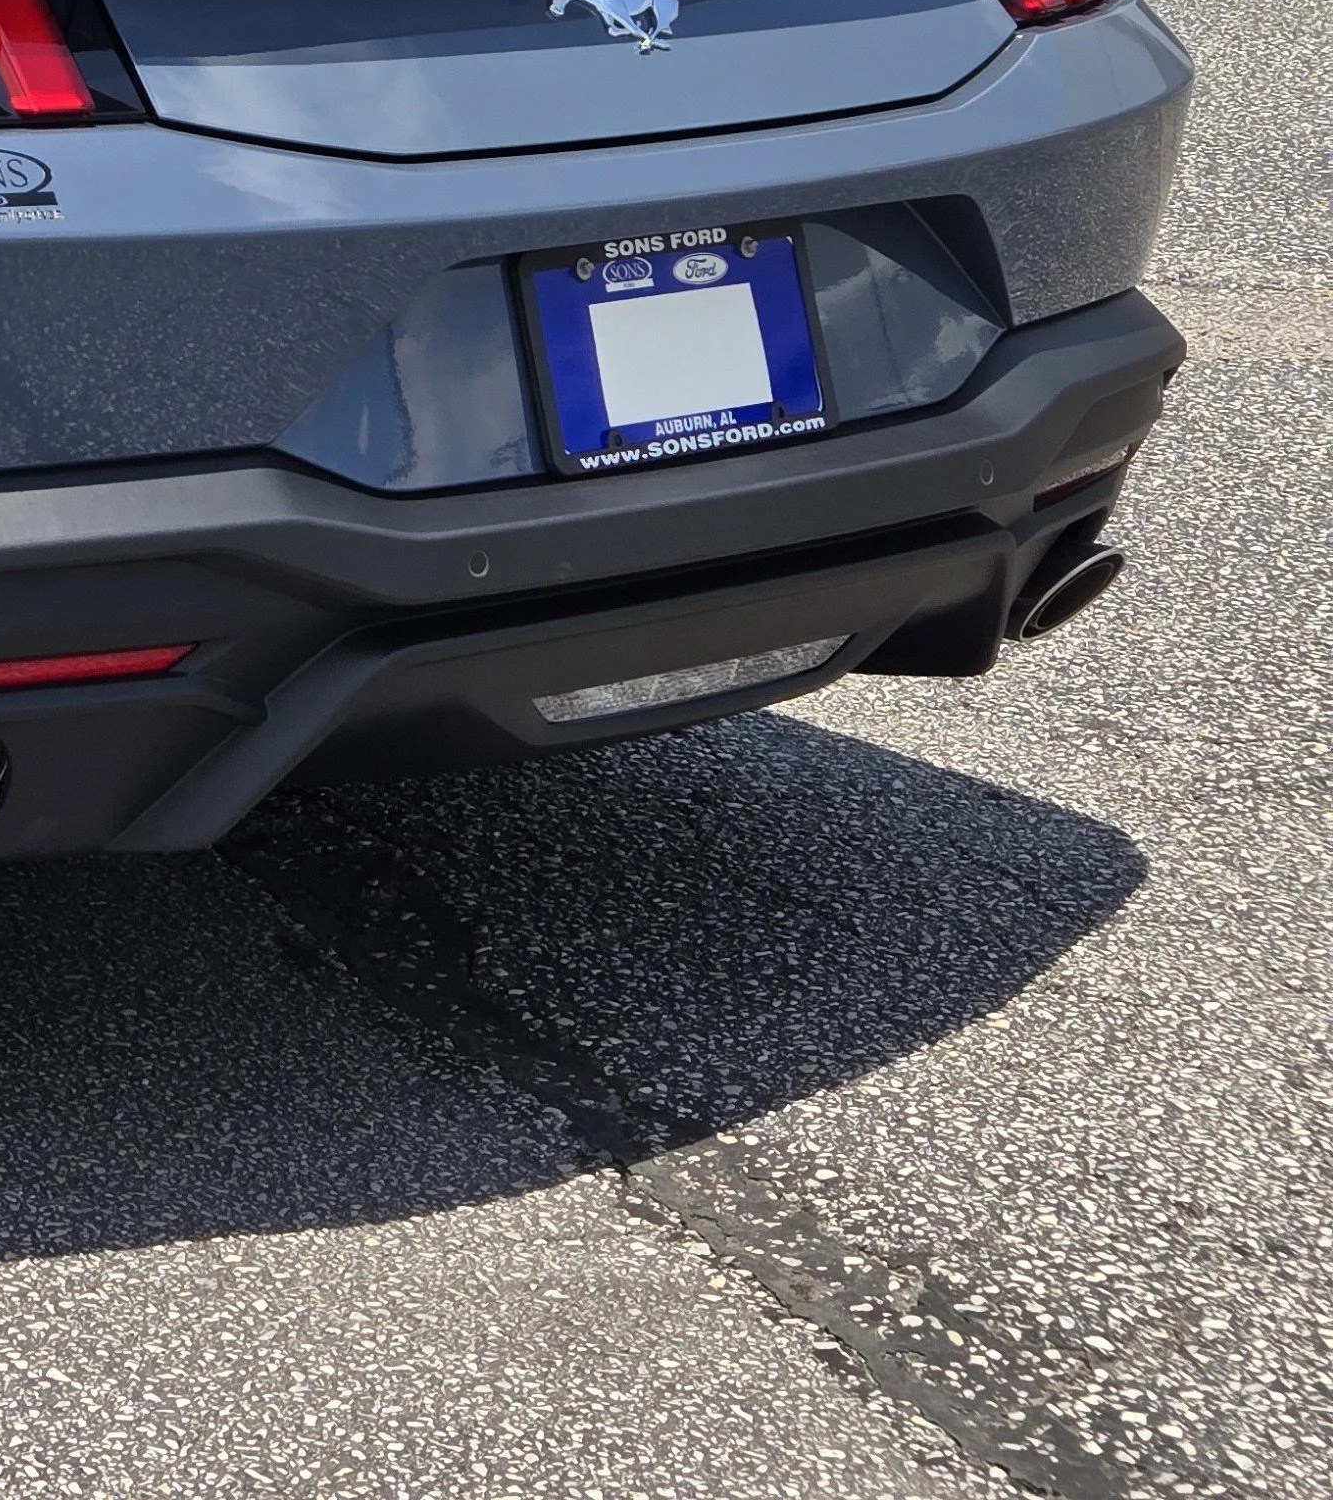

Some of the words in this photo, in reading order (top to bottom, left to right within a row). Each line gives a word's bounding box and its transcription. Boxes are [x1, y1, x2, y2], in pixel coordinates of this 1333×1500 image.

[604, 235, 665, 259] SONS
[669, 227, 727, 249] FORD
[610, 261, 647, 280] SONS
[685, 258, 718, 279] Ford
[655, 414, 717, 437] AUBURN,
[720, 411, 738, 426] AL
[579, 416, 826, 470] www.SONSFORD.com
